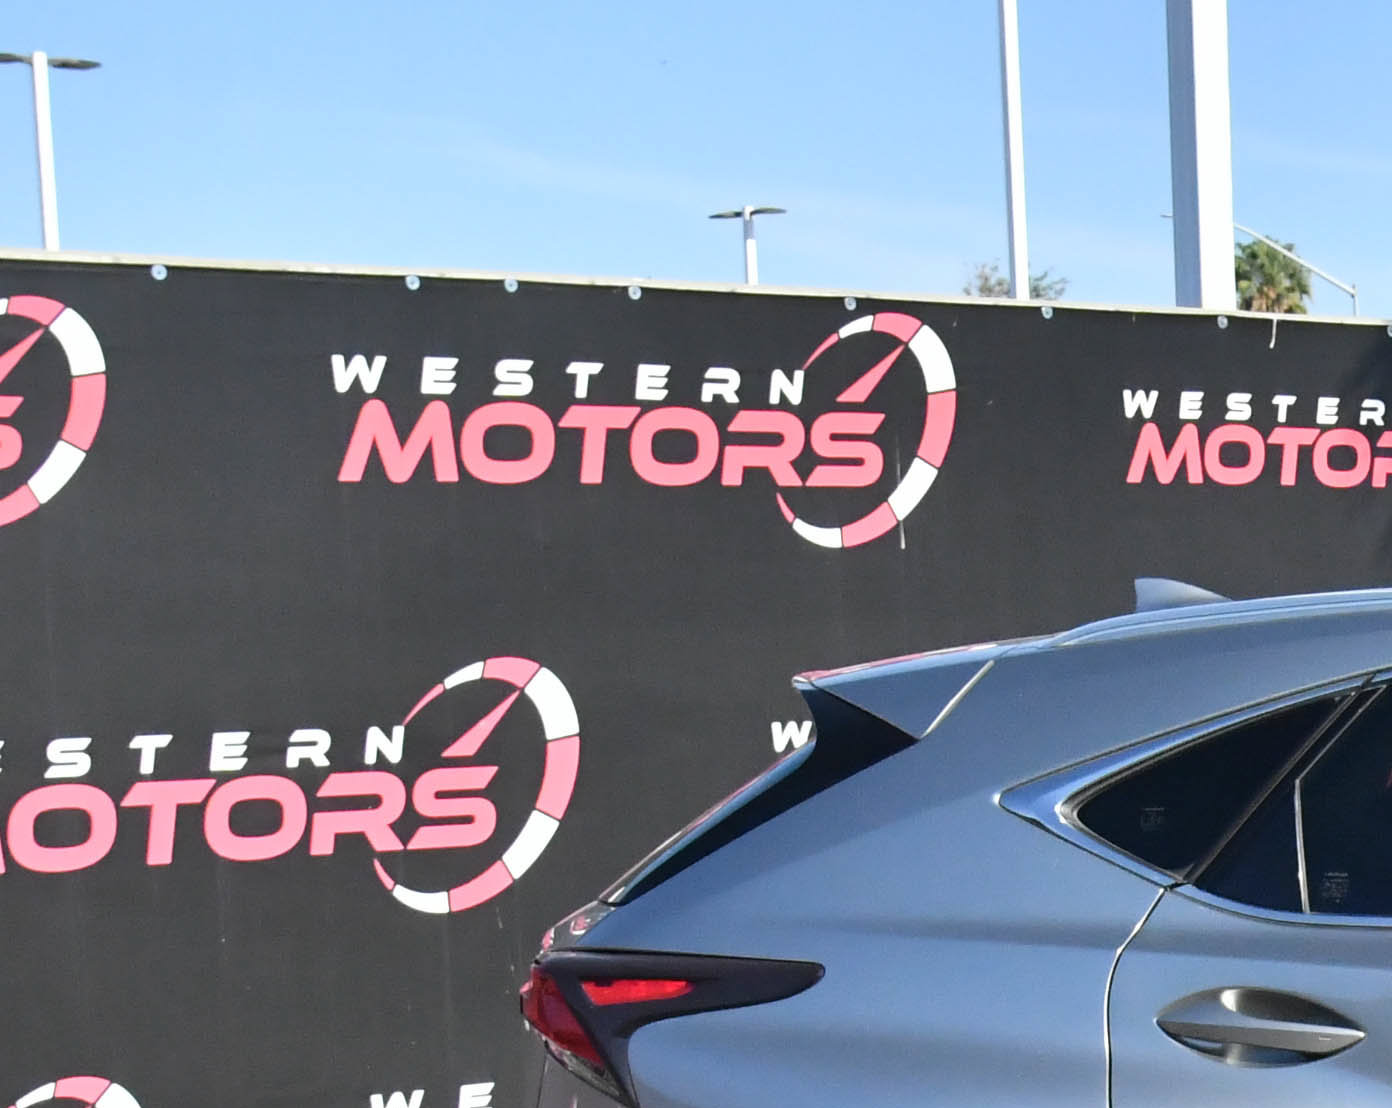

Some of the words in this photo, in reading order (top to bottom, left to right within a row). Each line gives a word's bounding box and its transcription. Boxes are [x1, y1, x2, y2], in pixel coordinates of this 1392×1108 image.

[330, 353, 805, 406] WESTERN
[337, 397, 886, 489] MOTORS
[0, 724, 405, 779] STERN
[0, 764, 499, 876] OTORS
